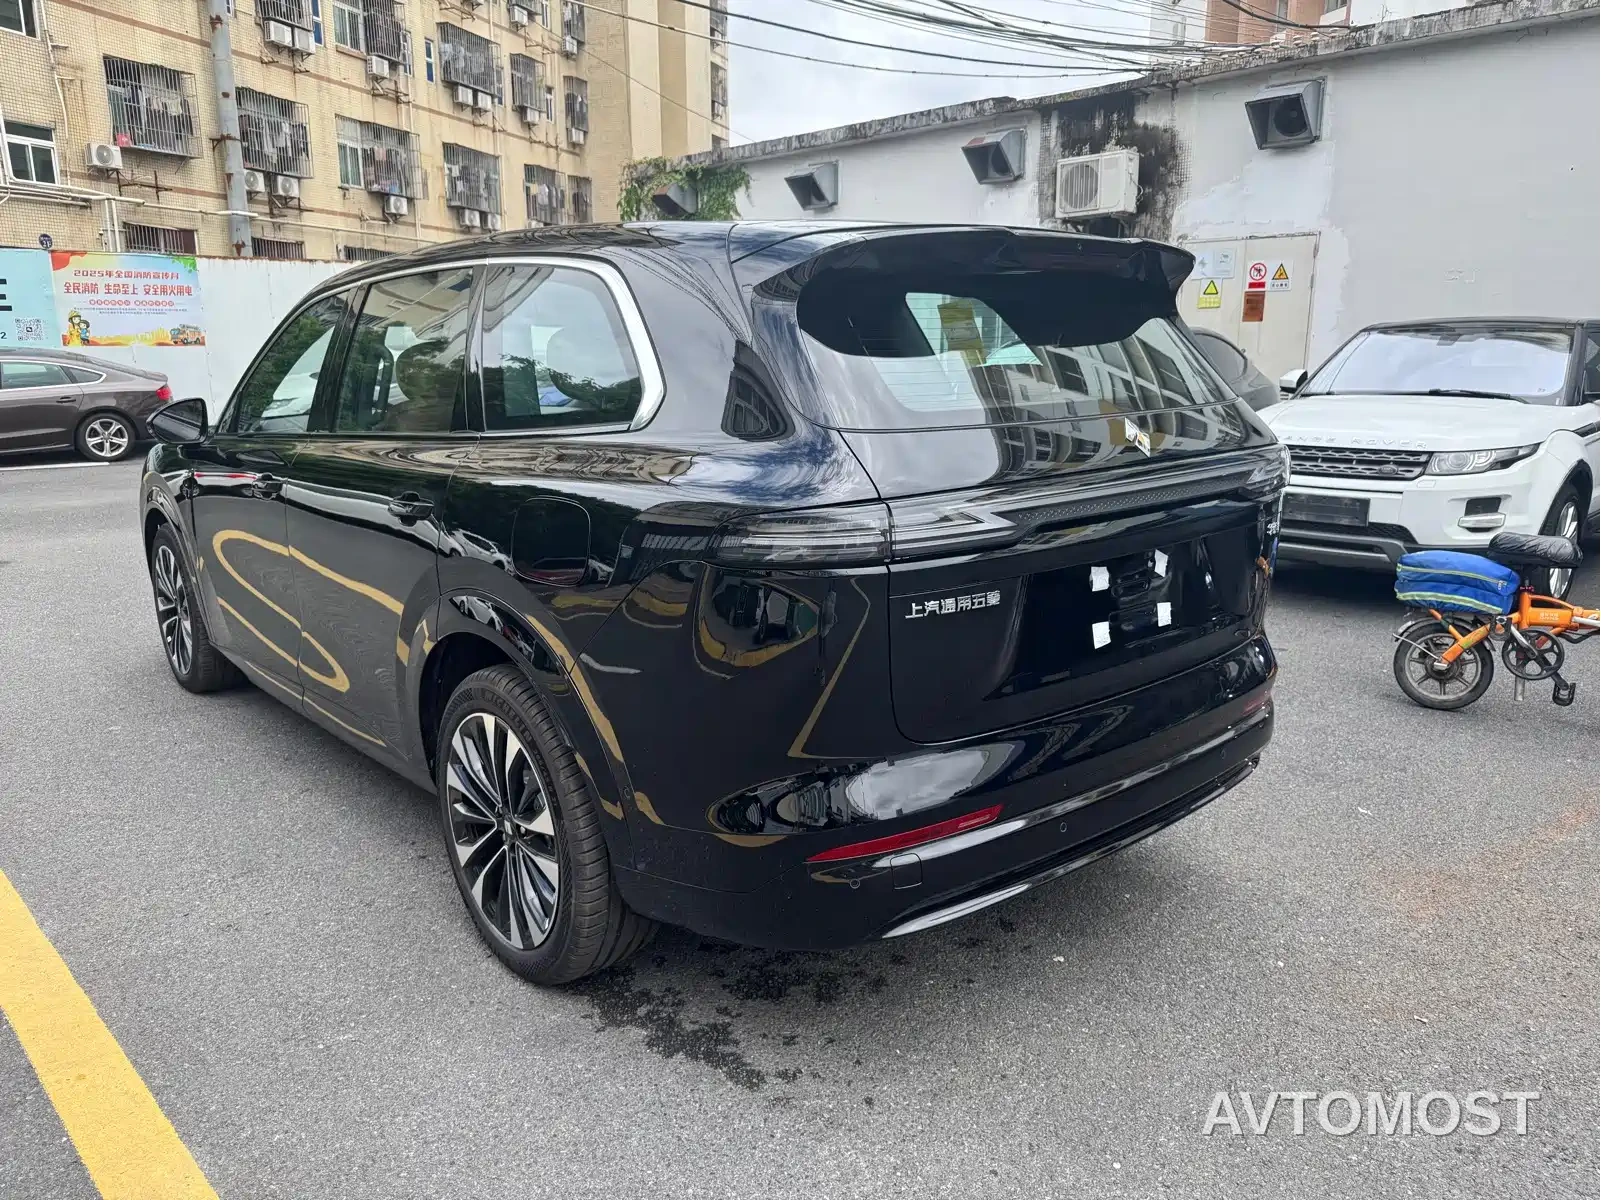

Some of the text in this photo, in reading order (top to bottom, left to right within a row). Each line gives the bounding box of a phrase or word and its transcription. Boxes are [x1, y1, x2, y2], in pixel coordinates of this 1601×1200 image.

[73, 269, 179, 280] 2025年全国消防宣传月
[63, 282, 193, 297] 全民消防 生命至上 安全用火用电
[1277, 435, 1428, 449] ANGE ROVER
[905, 590, 1001, 619] 上汽通用五菱
